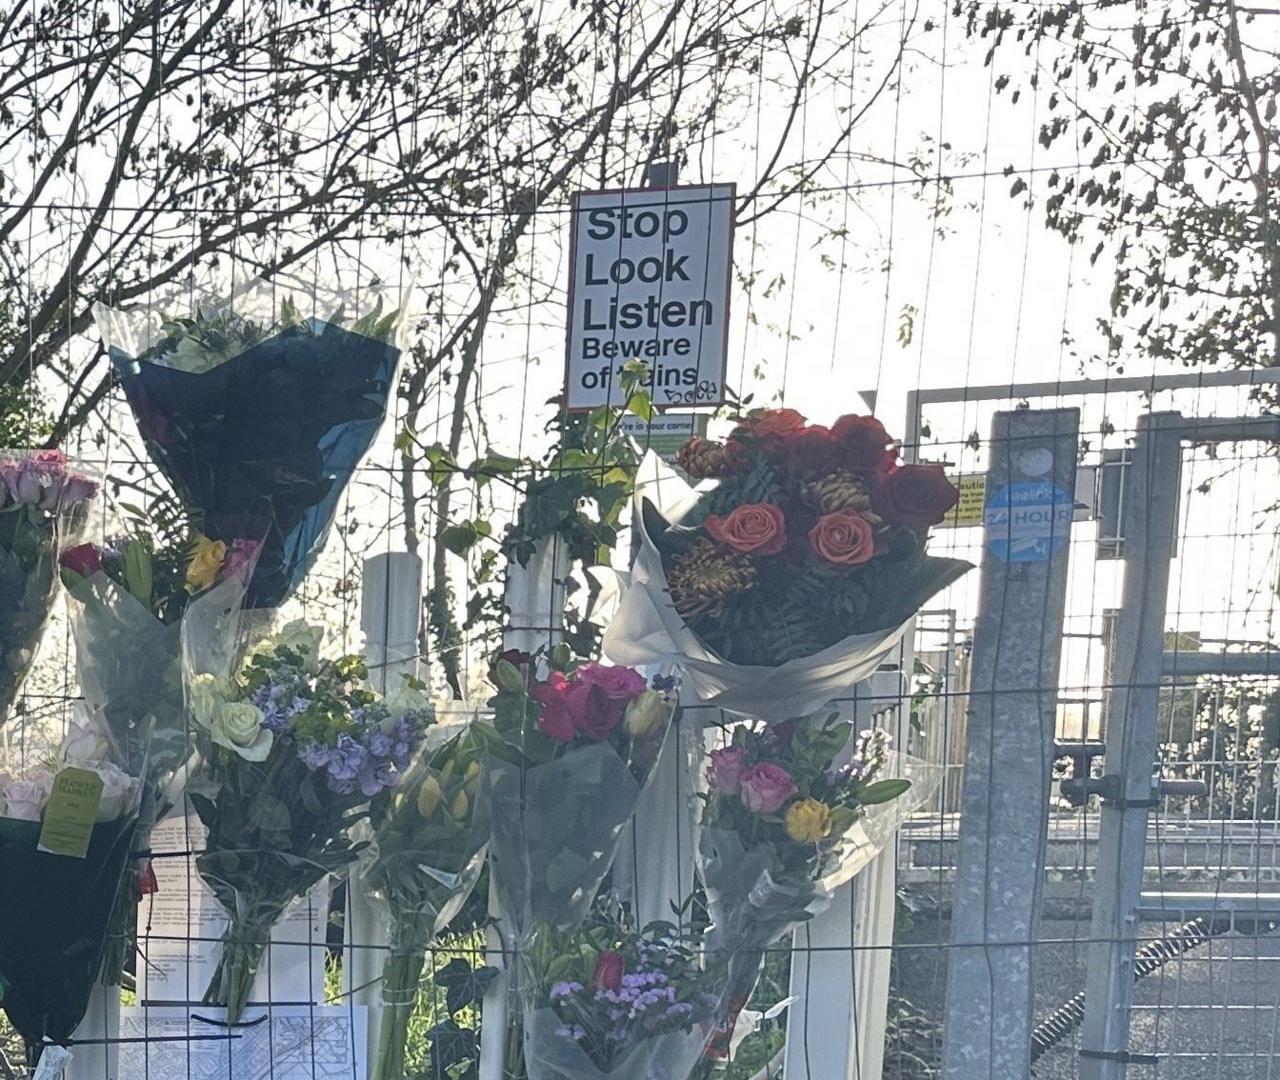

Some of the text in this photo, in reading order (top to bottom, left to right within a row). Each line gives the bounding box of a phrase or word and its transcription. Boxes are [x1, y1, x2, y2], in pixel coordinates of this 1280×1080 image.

[587, 207, 689, 243] Stop
[585, 249, 690, 286] Look
[583, 295, 713, 330] Listen
[582, 337, 691, 359] Beware
[581, 361, 697, 389] of ains
[987, 510, 1070, 525] 24 HOUR
